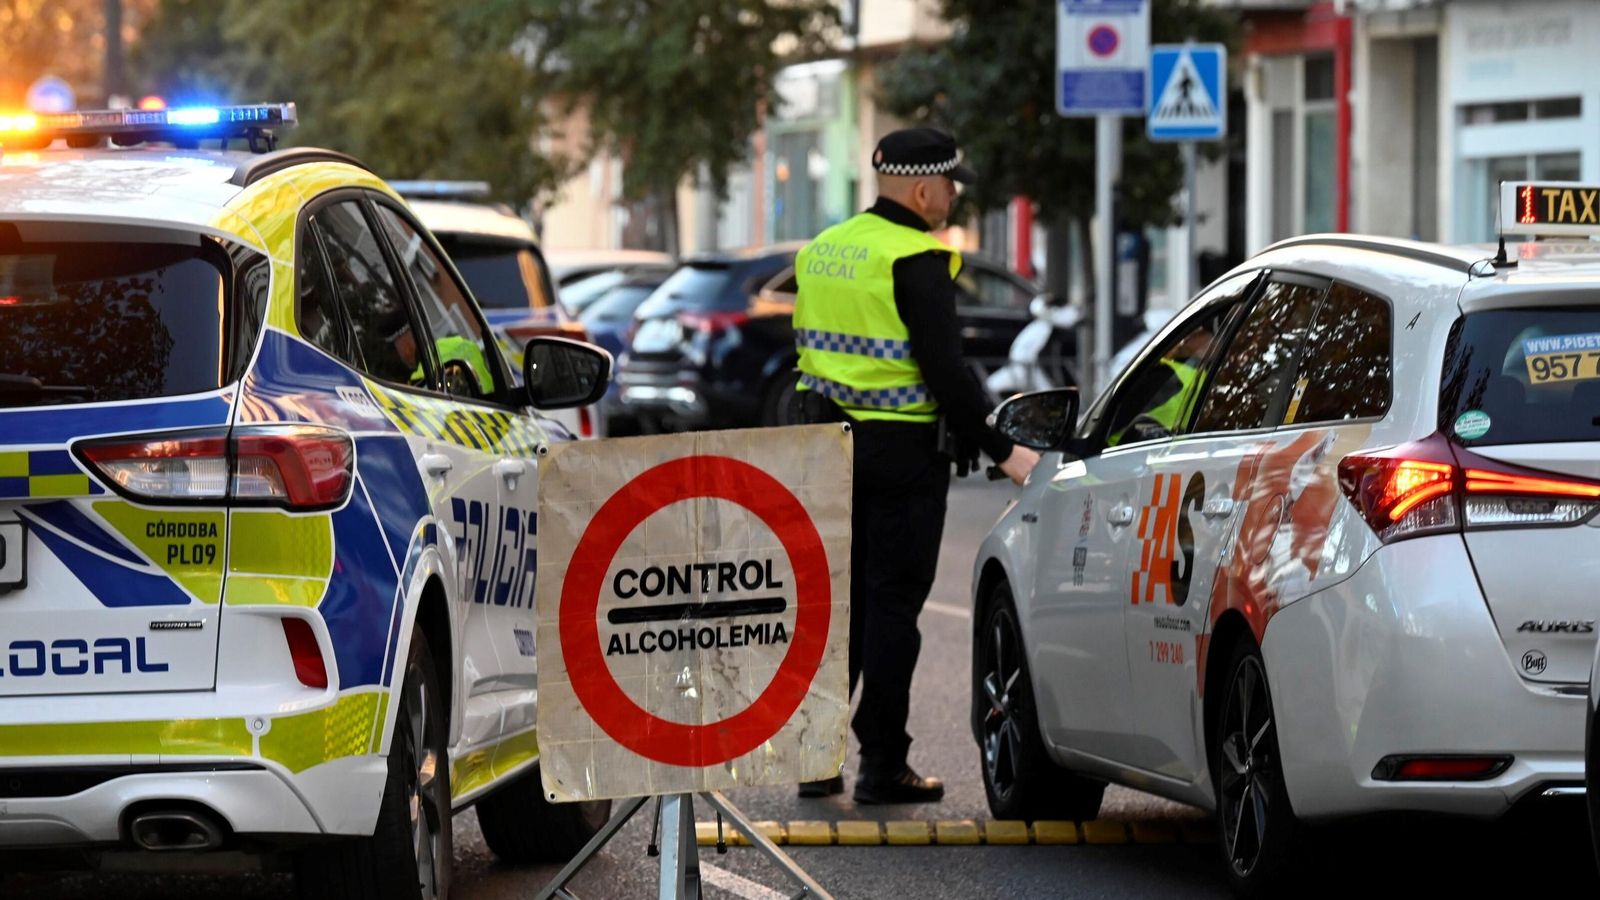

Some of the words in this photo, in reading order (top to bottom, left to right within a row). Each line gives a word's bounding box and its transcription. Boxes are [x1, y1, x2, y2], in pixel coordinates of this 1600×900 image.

[1542, 188, 1600, 223] TAX
[806, 260, 856, 281] LOCAL
[1532, 354, 1582, 381] 957
[146, 520, 218, 538] CÓRDOBA
[167, 544, 216, 566] PL09
[613, 558, 783, 599] CONTROL
[606, 622, 788, 656] ALCOHOLEMIA
[1516, 620, 1595, 633] AURIS
[0, 637, 169, 677] OCAL
